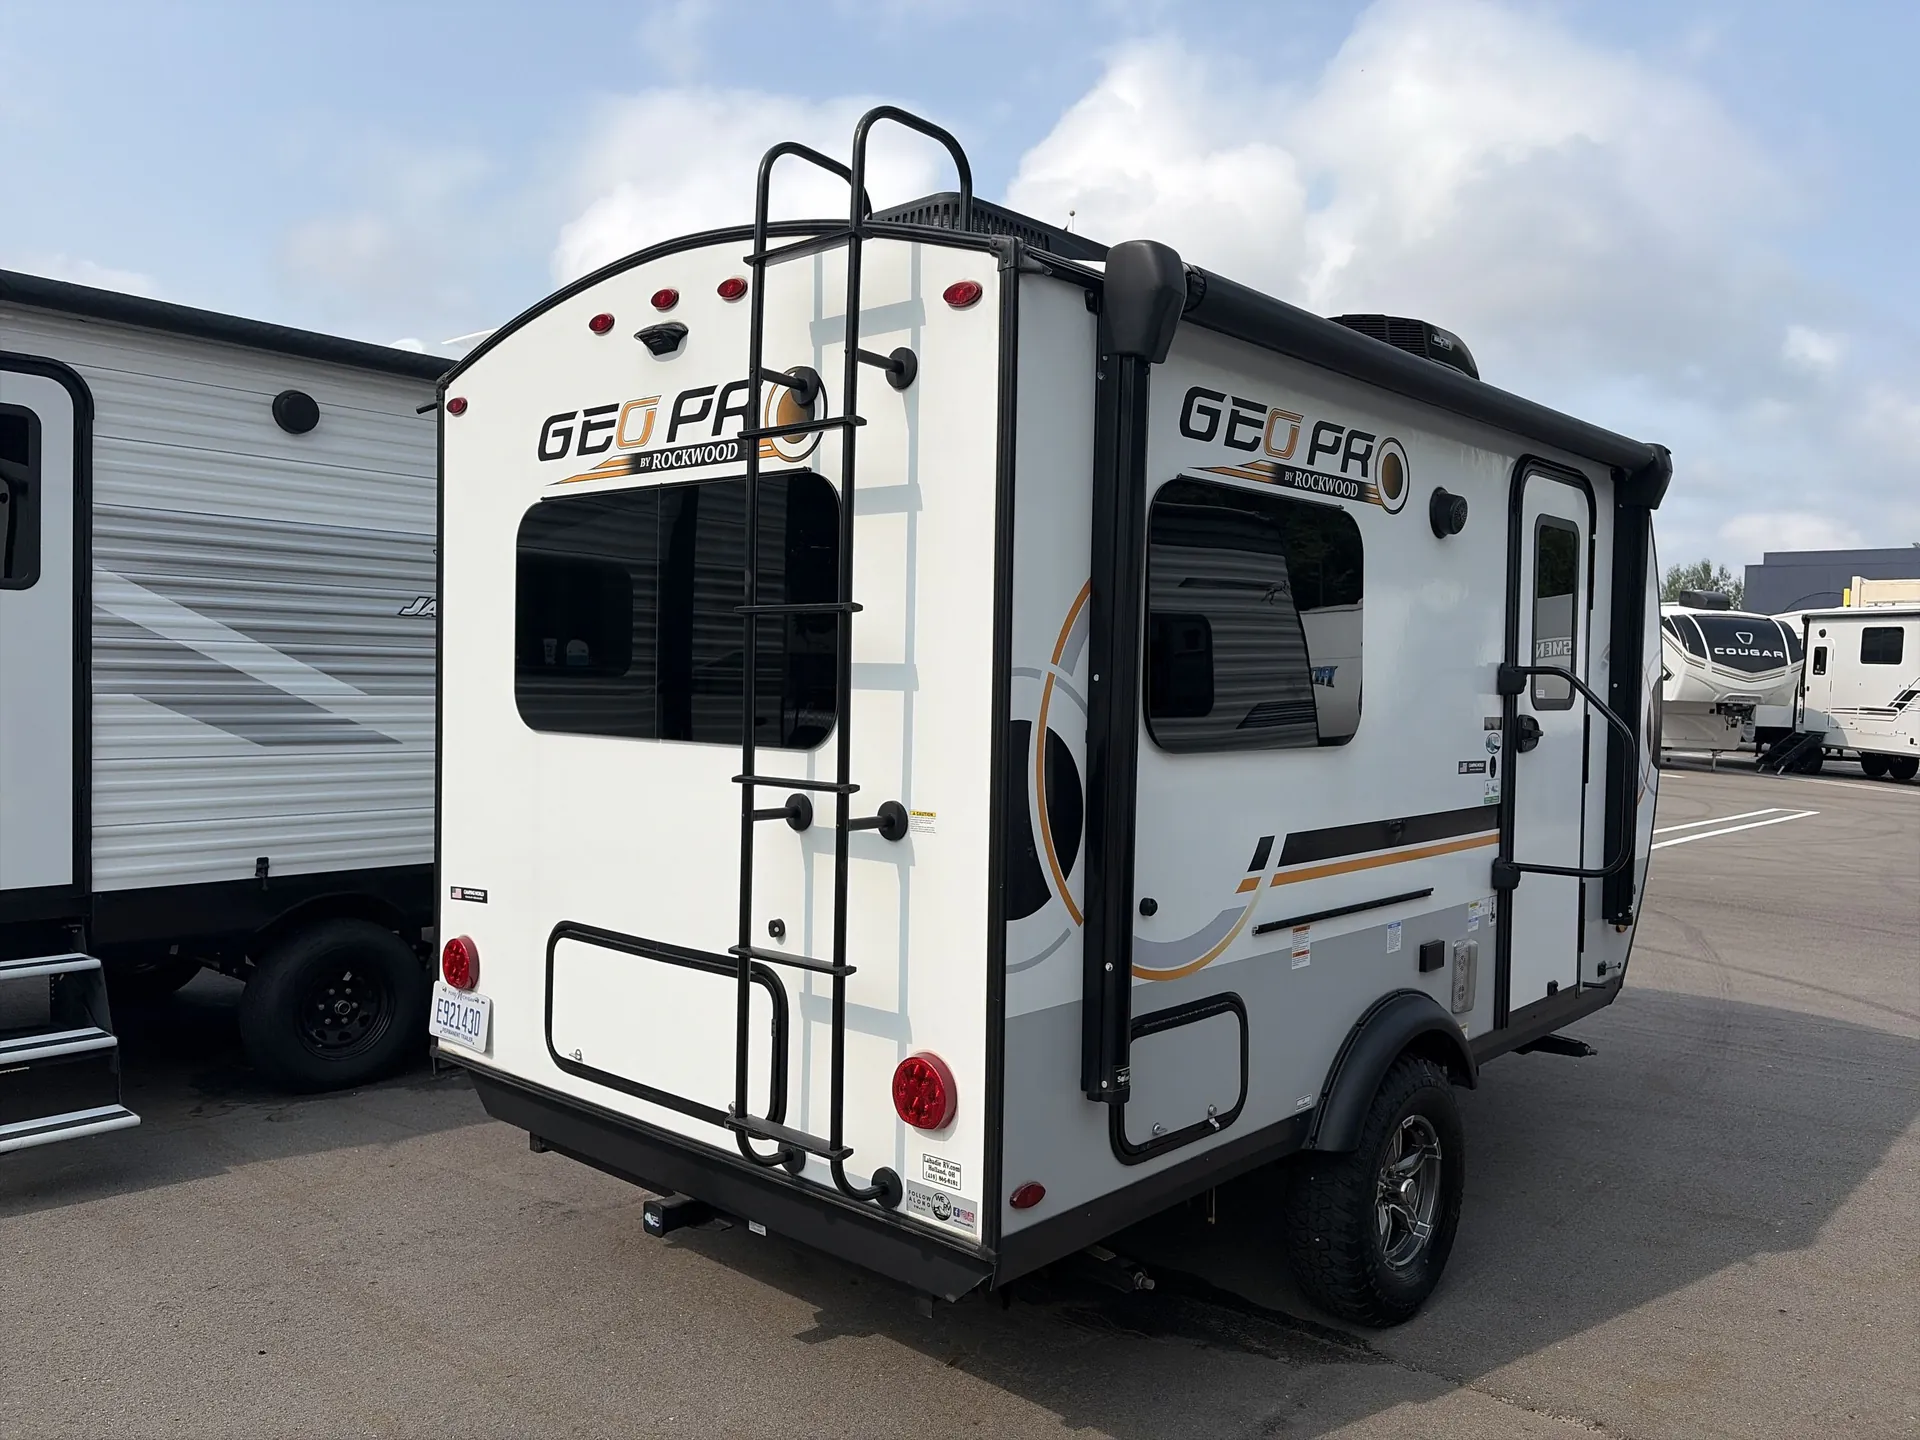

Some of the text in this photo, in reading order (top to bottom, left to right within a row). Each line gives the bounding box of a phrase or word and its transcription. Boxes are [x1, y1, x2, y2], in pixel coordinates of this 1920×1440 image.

[537, 394, 662, 462] GEO
[640, 442, 738, 470] BY ROCKWOOD
[1179, 386, 1410, 515] GEO PRO
[1284, 470, 1358, 498] BY ROCKWOOD
[1714, 647, 1784, 658] COUGAR
[436, 998, 480, 1037] E921430
[948, 1171, 956, 1179] OH
[908, 1189, 931, 1202] FOLLOW
[908, 1196, 931, 1208] ALONG
[935, 1195, 945, 1204] WE
